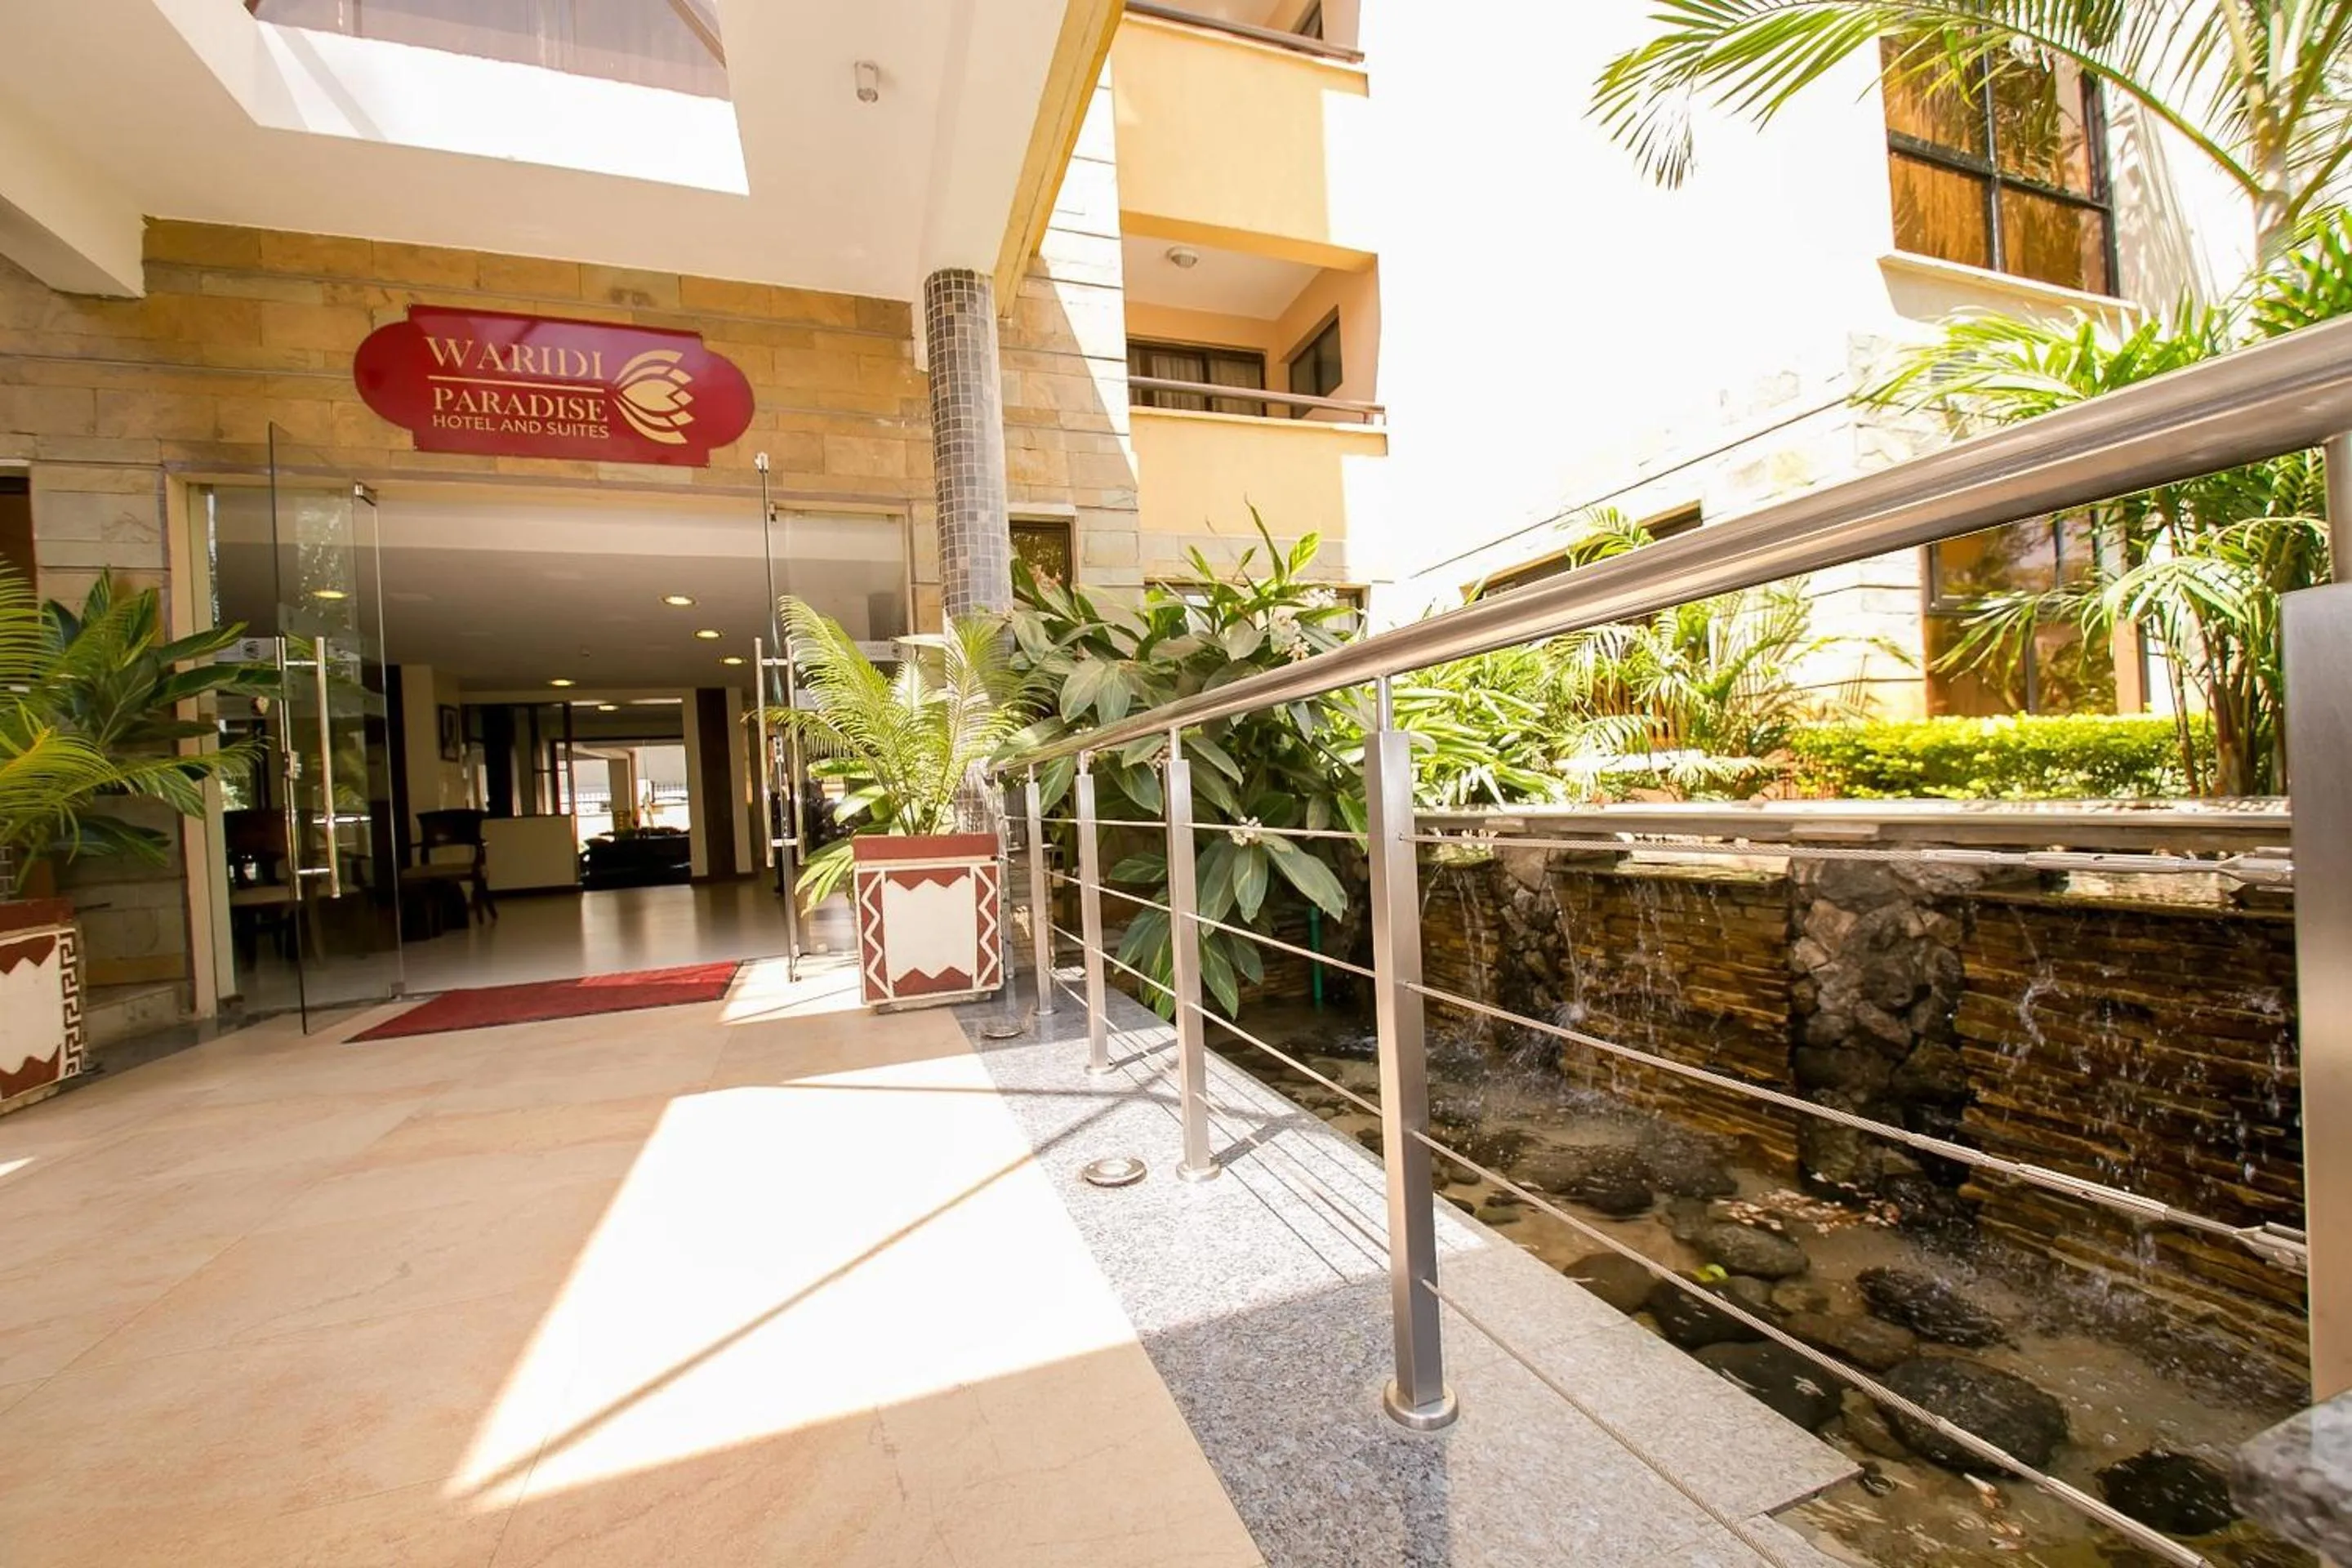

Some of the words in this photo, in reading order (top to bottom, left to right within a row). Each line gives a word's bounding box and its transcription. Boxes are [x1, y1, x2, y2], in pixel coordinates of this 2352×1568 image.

[424, 336, 603, 379] WARIDI
[433, 387, 608, 422] PARADISE
[433, 414, 495, 431] HOTEL
[500, 419, 541, 434] AND
[546, 423, 610, 439] SUITES
